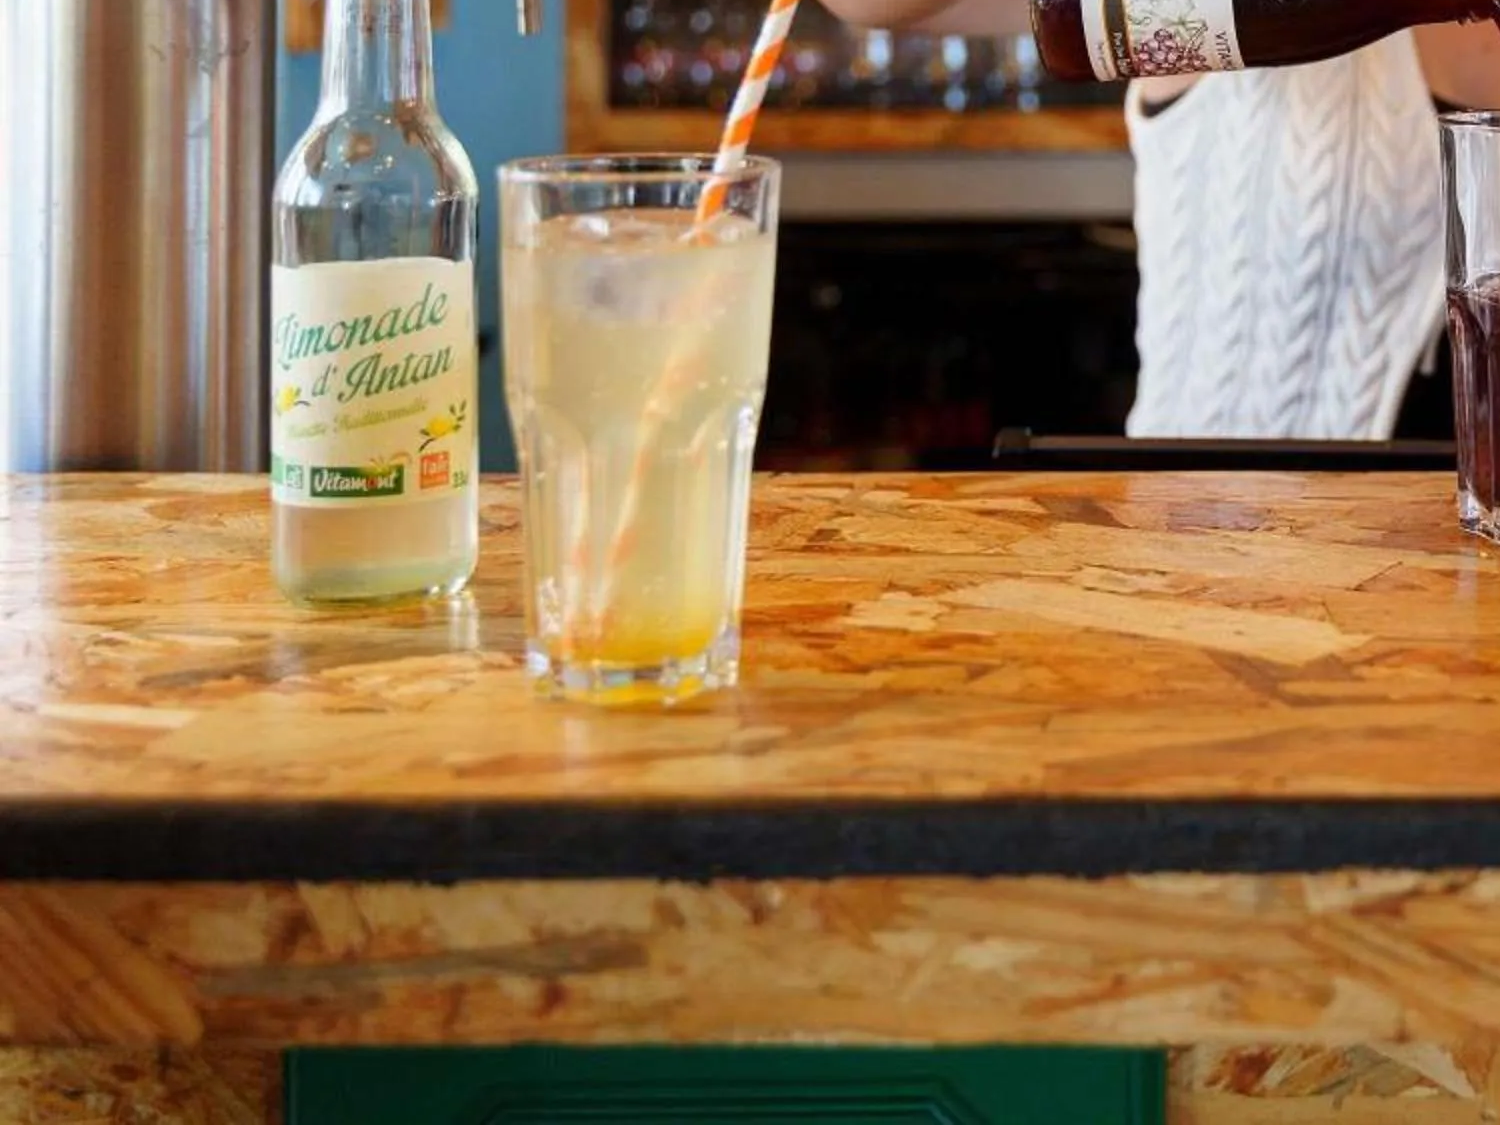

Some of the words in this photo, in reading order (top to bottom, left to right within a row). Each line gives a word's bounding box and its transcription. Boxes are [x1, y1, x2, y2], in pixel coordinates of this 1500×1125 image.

[275, 282, 448, 370] Limonade
[310, 344, 453, 403] d'Antan
[314, 466, 397, 492] Vitamont
